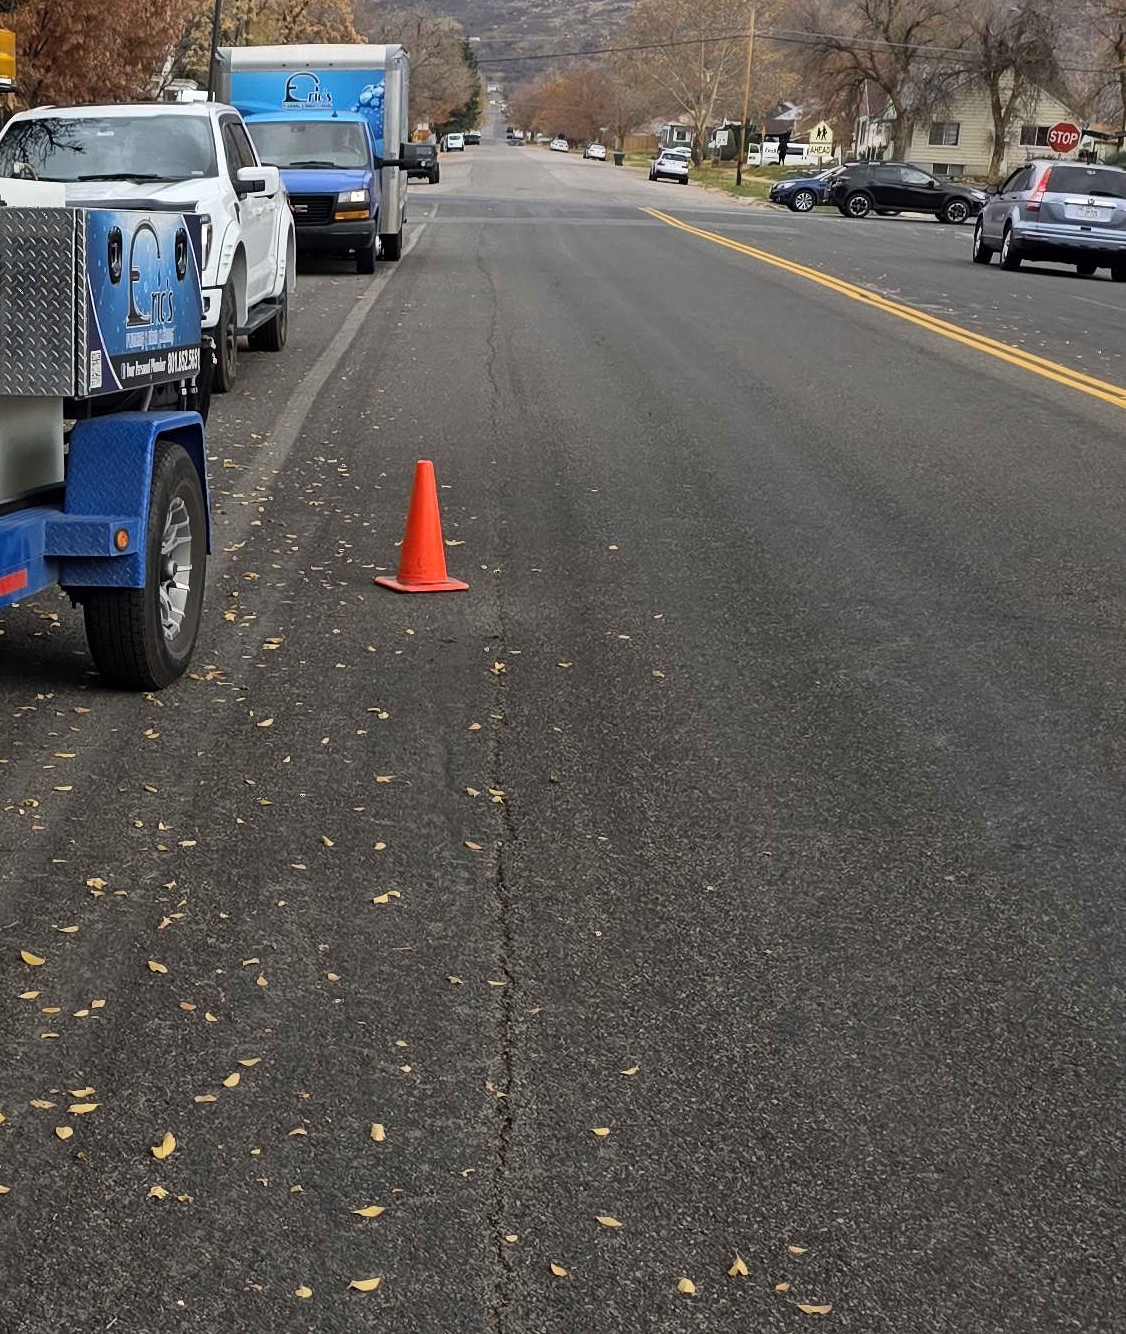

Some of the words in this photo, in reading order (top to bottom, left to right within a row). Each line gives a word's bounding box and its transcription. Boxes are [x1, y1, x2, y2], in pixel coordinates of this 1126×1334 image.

[1049, 130, 1078, 145] STOP
[810, 146, 830, 154] AHEAD
[126, 218, 174, 328] Eric's
